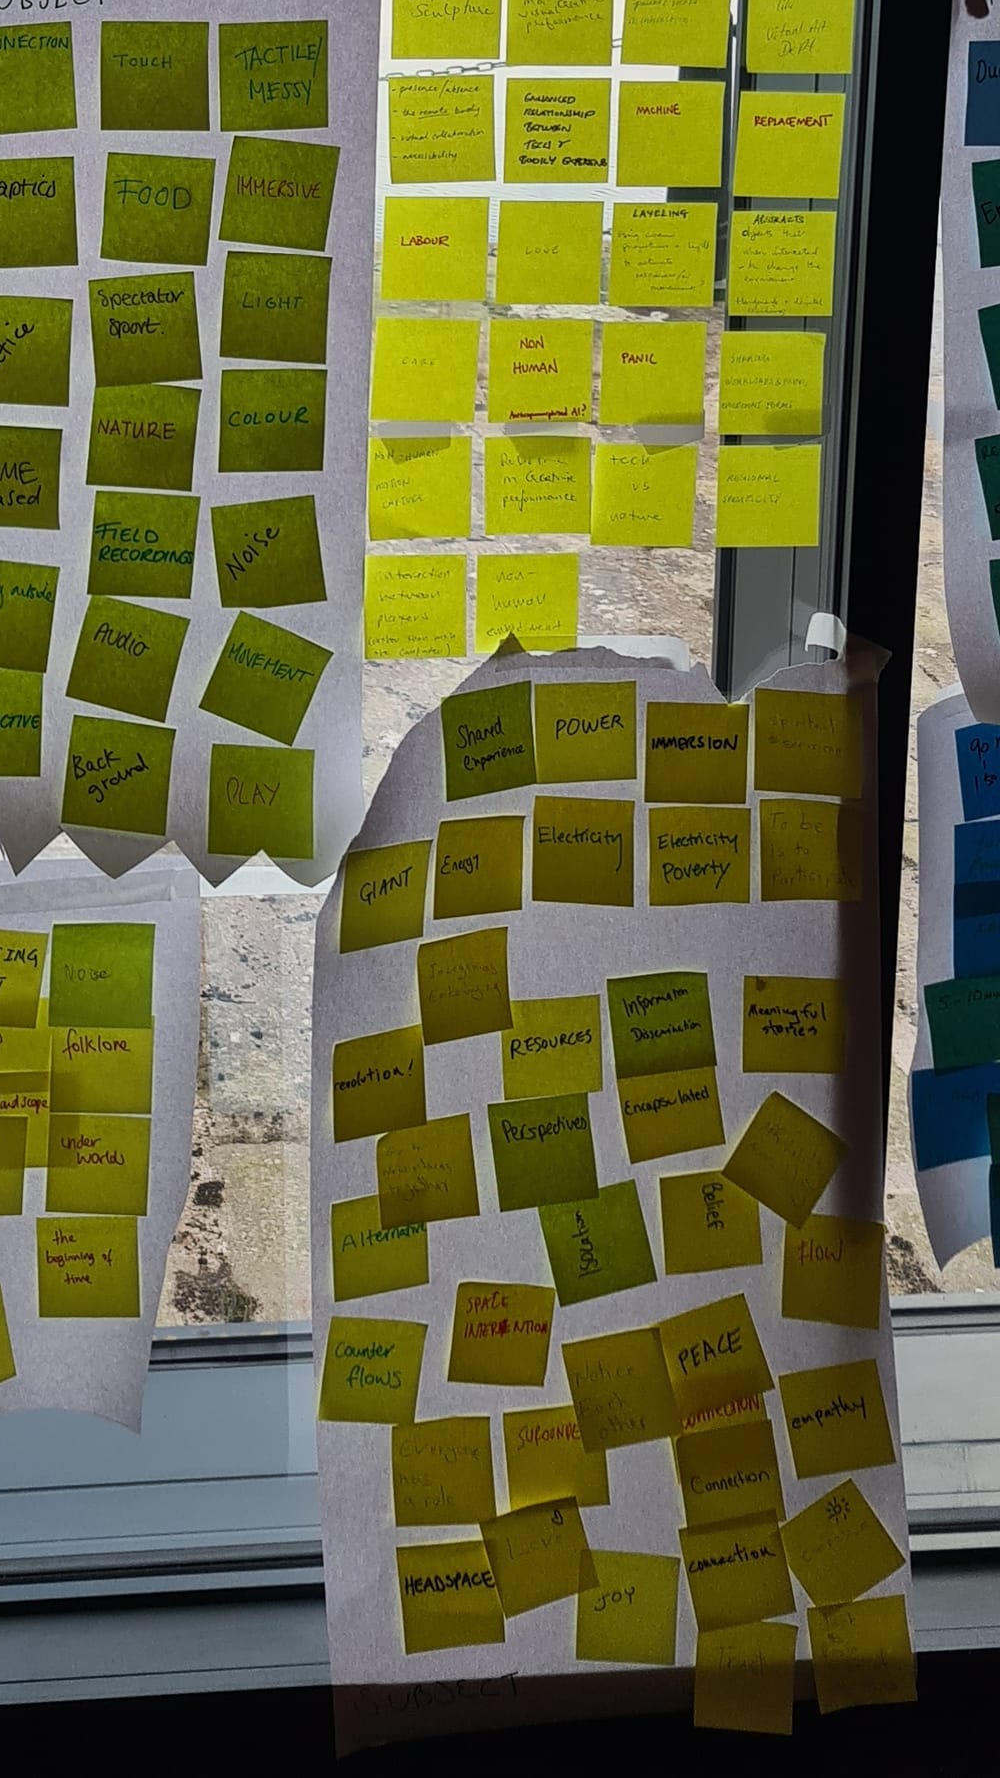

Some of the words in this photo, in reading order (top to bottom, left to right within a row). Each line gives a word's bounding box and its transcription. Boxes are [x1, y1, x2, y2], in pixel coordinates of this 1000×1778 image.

[111, 52, 173, 71] TOUCH
[248, 79, 313, 107] MESSY
[634, 102, 683, 117] MACHINE
[753, 113, 833, 129] REPLACEMENT
[112, 177, 194, 211] FOOD
[235, 173, 322, 200] IMMERSIVE
[399, 234, 451, 248] LABOUR
[96, 288, 186, 311] Spectator
[241, 291, 304, 310] LIGHT
[518, 334, 546, 352] NON
[511, 358, 559, 375] HUMAN
[619, 351, 659, 365] PANIC
[96, 418, 177, 441] NATURE
[227, 406, 310, 428] COLOUR
[93, 521, 160, 544] FIELD
[97, 546, 194, 565] RECORDINGS
[224, 526, 281, 582] Noise
[92, 620, 151, 658] Audio
[226, 641, 316, 684] MOVEMENT
[455, 717, 505, 751] Shared
[554, 713, 625, 741] POWER
[650, 733, 740, 752] IMMERSION
[71, 748, 122, 780] Back
[87, 751, 150, 804] ground
[225, 776, 281, 807] PLAY
[537, 825, 624, 875] Electricity
[656, 831, 740, 855] Electricity
[359, 864, 414, 906] GIANT
[661, 861, 732, 891] Poverty
[61, 1027, 132, 1061] folklore
[509, 1027, 593, 1060] RESOURCES
[623, 1084, 710, 1118] Encapsulated
[501, 1115, 589, 1144] Perspectives
[51, 1228, 78, 1247] the
[45, 1248, 97, 1269] beginning
[101, 1247, 114, 1267] of
[63, 1271, 94, 1286] time
[333, 1341, 397, 1360] Counter
[676, 1325, 744, 1375] PEACE
[790, 1393, 868, 1431] empathy
[403, 1569, 497, 1597] HEADSPACE
